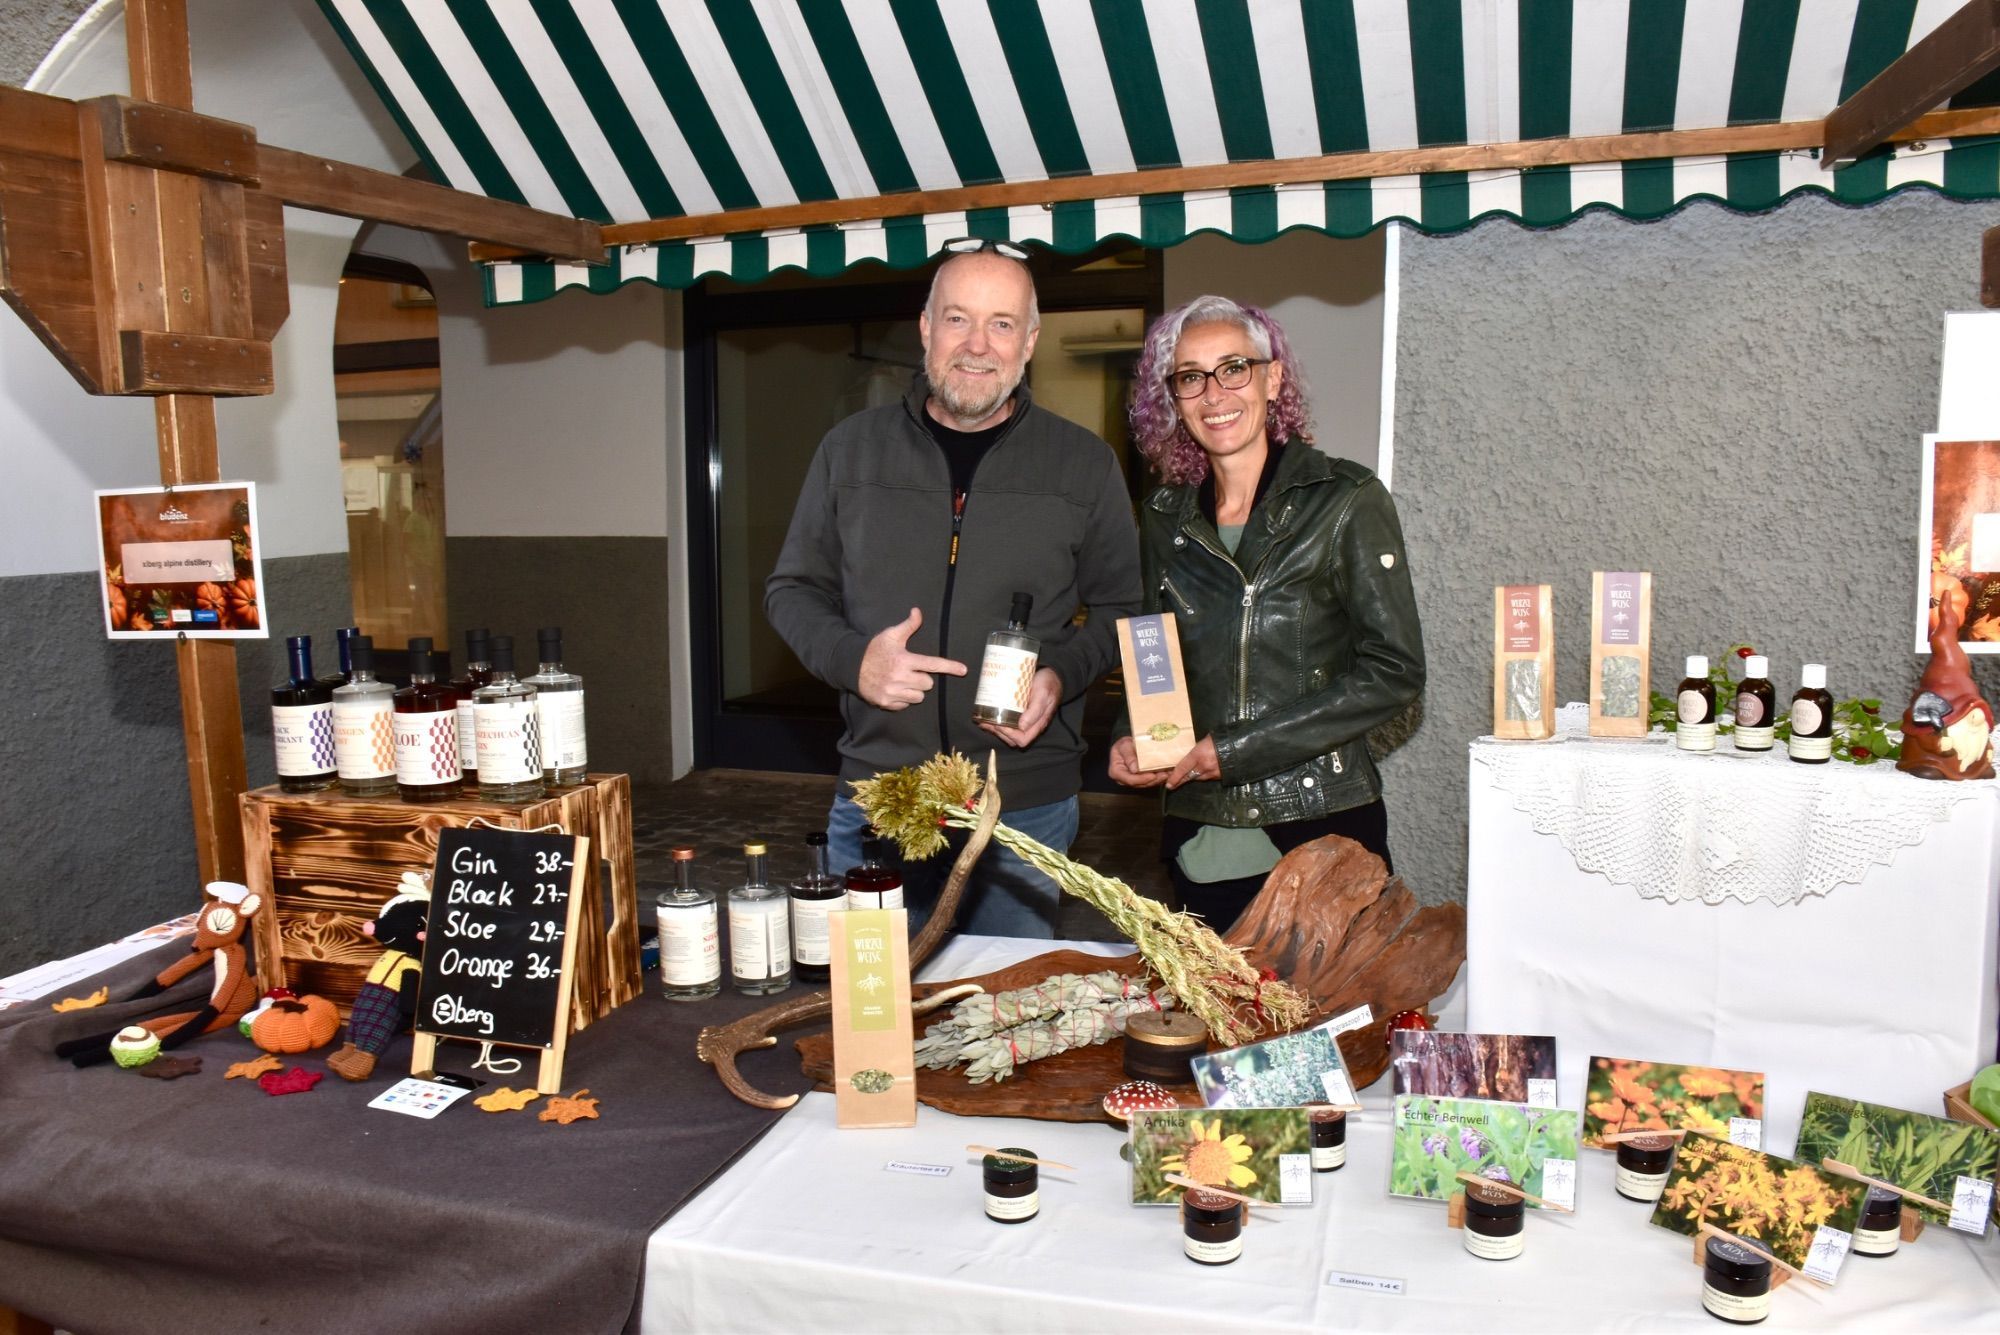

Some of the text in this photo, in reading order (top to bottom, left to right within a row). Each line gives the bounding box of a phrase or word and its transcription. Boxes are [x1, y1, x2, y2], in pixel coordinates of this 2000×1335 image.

[163, 559, 183, 569] alpine
[184, 558, 213, 568] distillery
[452, 846, 498, 875] Gin
[447, 878, 514, 907] Black
[443, 910, 497, 940] Sloe
[439, 947, 514, 989] Orange
[1143, 1115, 1186, 1129] Arnika
[1404, 1109, 1440, 1122] Echter
[1442, 1112, 1490, 1126] Beinwell
[1338, 1277, 1375, 1287] Salben
